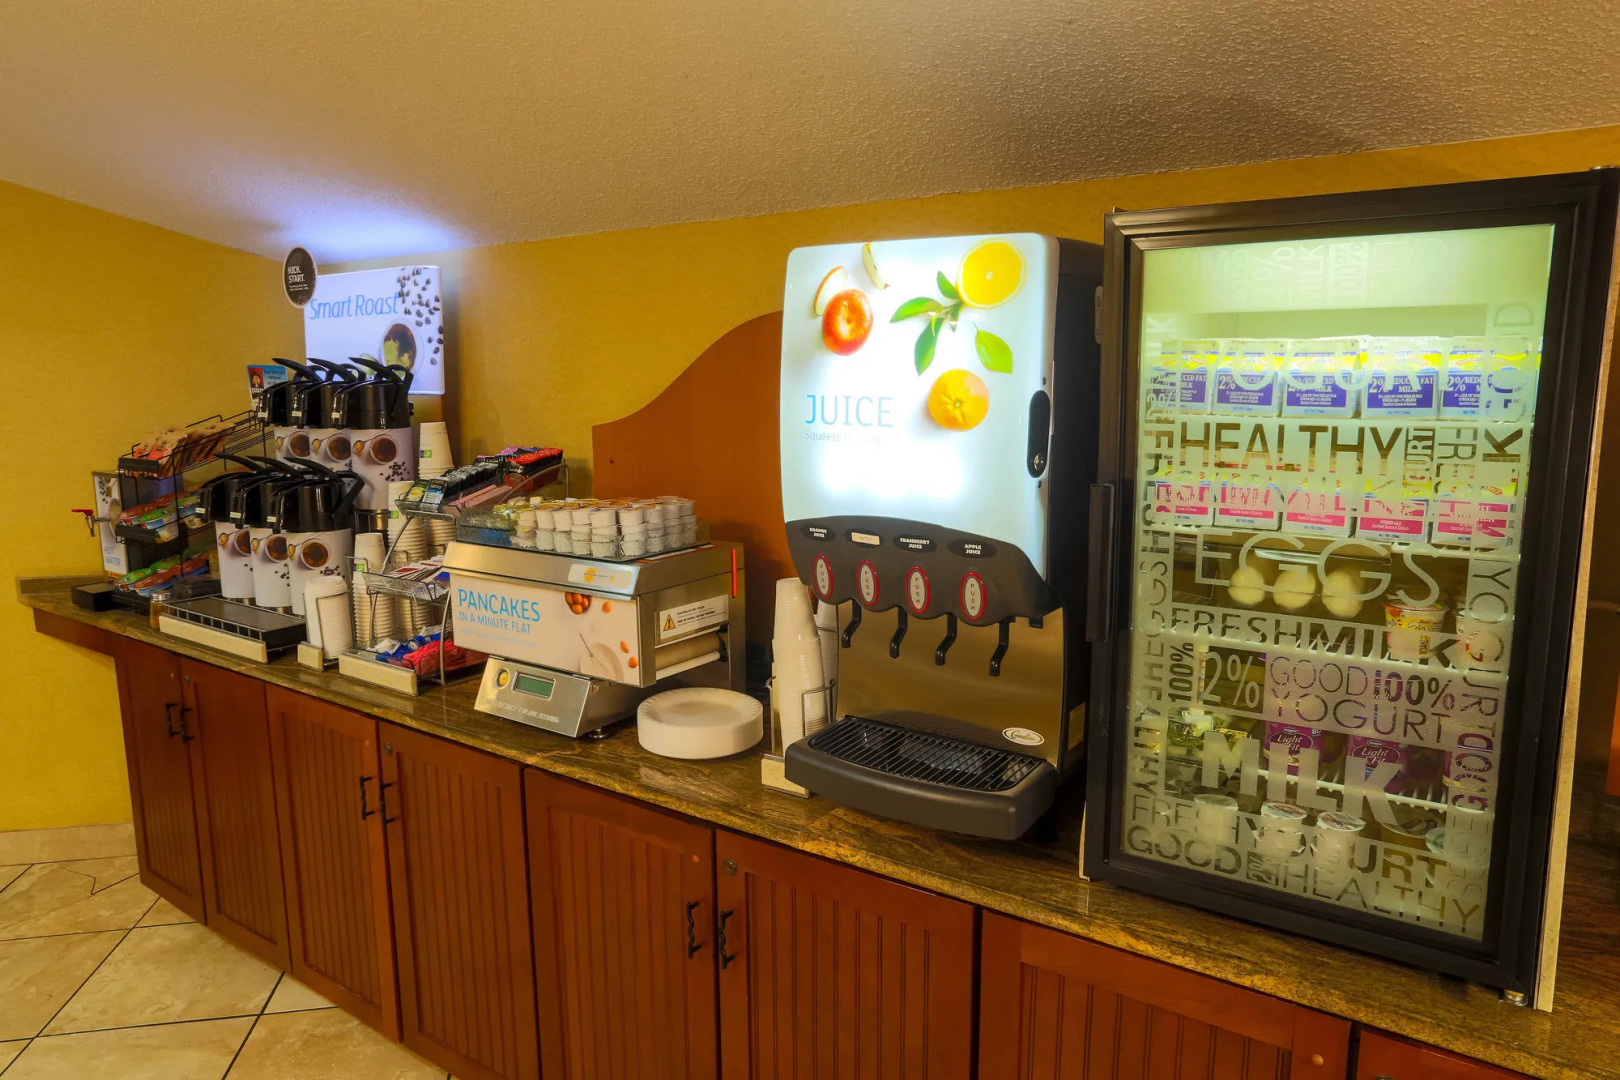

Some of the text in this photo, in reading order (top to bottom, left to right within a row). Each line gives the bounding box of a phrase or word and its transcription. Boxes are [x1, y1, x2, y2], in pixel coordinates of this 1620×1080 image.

[289, 274, 305, 283] START.
[310, 292, 400, 320] Smart Roast
[805, 394, 894, 428] JUICE
[1180, 421, 1403, 476] HEALTHY
[900, 537, 930, 545] CRANBERRY
[863, 570, 872, 597] PUSH
[1194, 529, 1441, 609] EGGS
[458, 588, 541, 622] PANCAKES
[969, 583, 977, 611] PUSH
[459, 611, 531, 634] IN A MINUTE FLAT
[1169, 607, 1465, 670] FRESH MILK
[1167, 642, 1195, 703] 100%
[1201, 648, 1261, 711] 2%
[1269, 656, 1369, 697] GOOD
[1373, 668, 1455, 711] 100%
[1271, 686, 1451, 744] YOGURT
[1277, 734, 1303, 746] Light
[1361, 747, 1389, 759] Light
[1202, 730, 1402, 826] MILK
